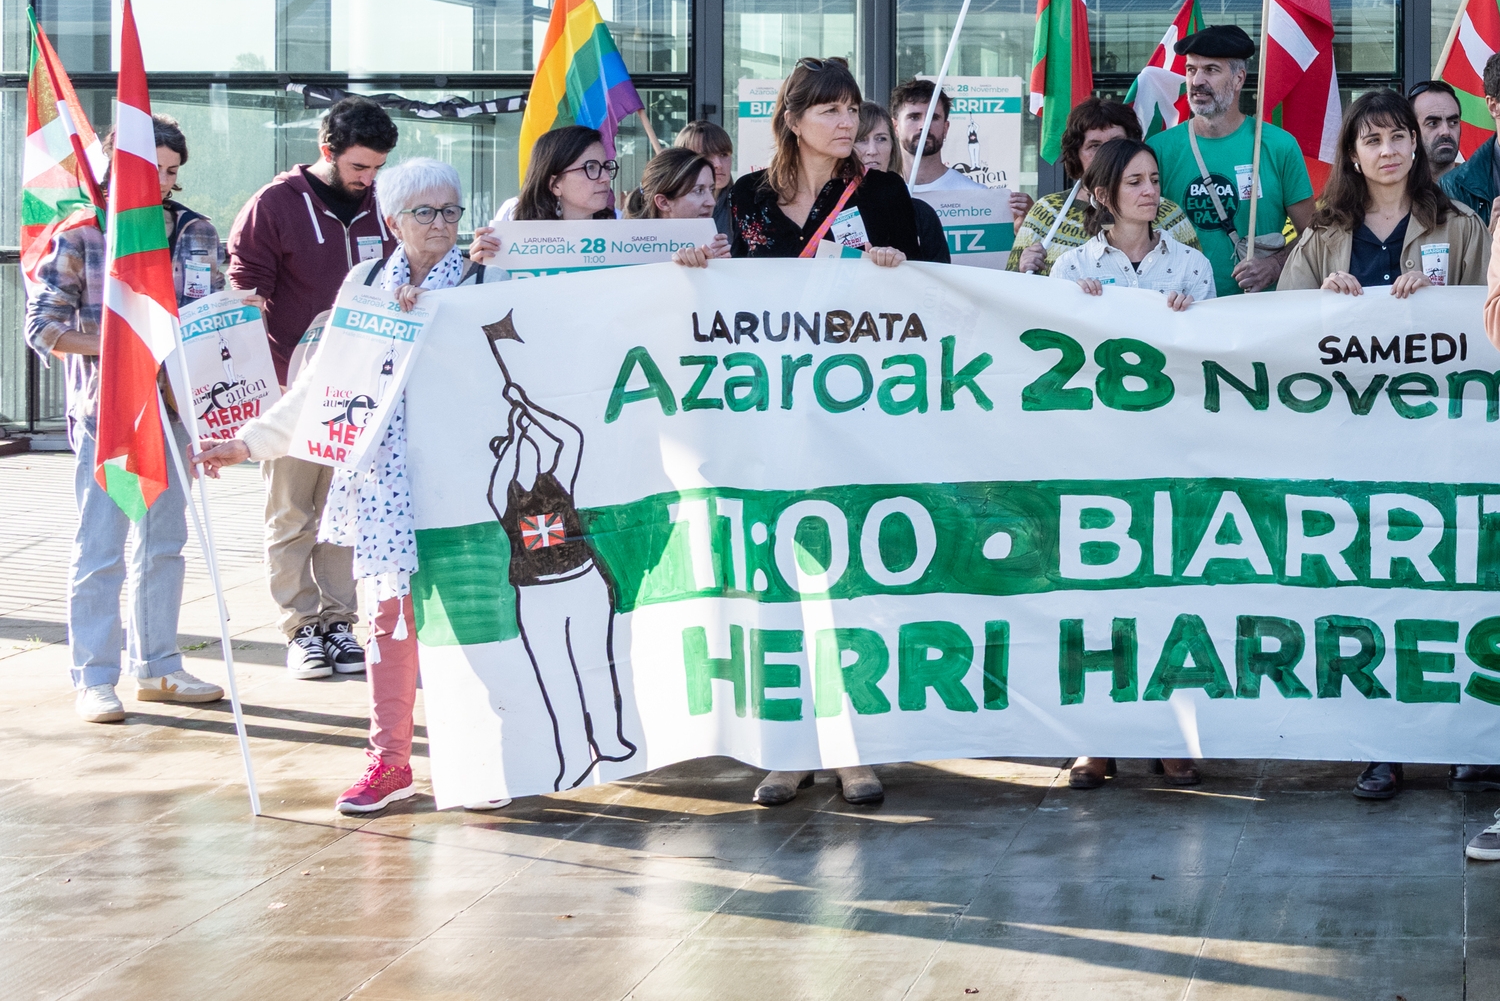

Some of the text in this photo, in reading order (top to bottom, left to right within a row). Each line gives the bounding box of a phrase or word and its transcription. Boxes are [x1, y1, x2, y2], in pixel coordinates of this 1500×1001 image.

[957, 84, 969, 93] 28
[971, 85, 1010, 93] Novembre
[935, 206, 992, 218] ovembre
[508, 239, 576, 255] Azaroak
[579, 237, 606, 254] 28
[523, 236, 566, 244] LARUNBATA
[583, 254, 606, 264] 11:00
[196, 303, 210, 315] 28
[352, 294, 386, 309] Azaroak
[387, 301, 401, 313] 28
[180, 309, 247, 340] IARRITZ
[345, 310, 422, 341] BIARRIT
[691, 309, 1468, 365] LARUNBATA SAMEDI
[603, 334, 995, 424] Azaroak
[1020, 328, 1176, 413] 28
[192, 384, 210, 397] ace
[325, 386, 353, 399] Face
[202, 399, 260, 429] HERRI
[668, 495, 937, 597] 11:00
[682, 618, 1011, 722] HERRI
